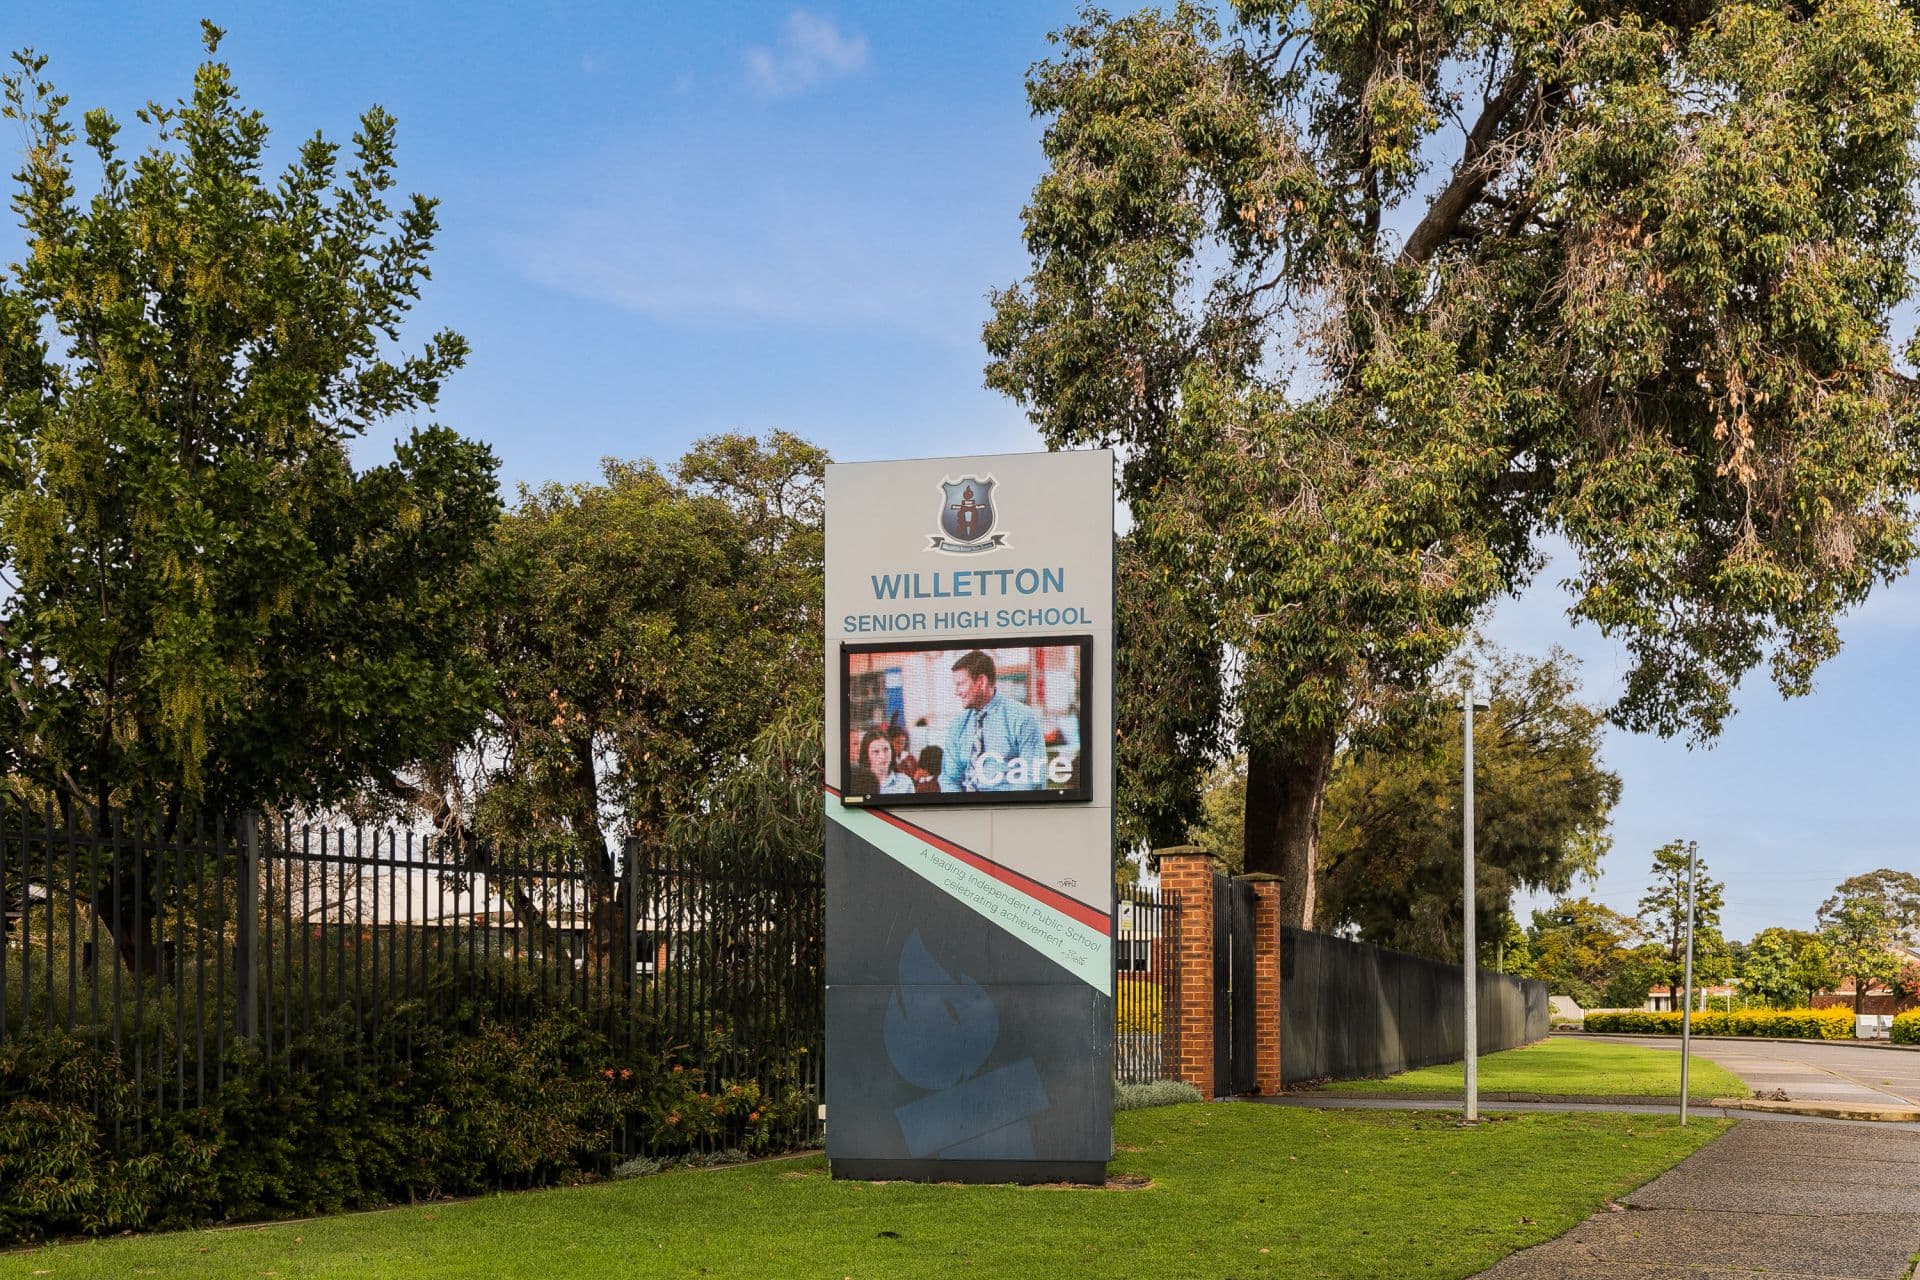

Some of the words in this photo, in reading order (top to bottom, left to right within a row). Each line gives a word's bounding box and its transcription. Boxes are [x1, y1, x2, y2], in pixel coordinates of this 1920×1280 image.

[871, 567, 1064, 600] WILLETTON
[844, 612, 926, 632] SENIOR
[934, 611, 988, 629] HIGH
[996, 607, 1092, 628] SCHOOL
[974, 753, 1073, 785] Care
[920, 848, 928, 859] A
[930, 853, 966, 880] leading
[968, 874, 1030, 914] Independent
[1032, 909, 1063, 932] Public
[1065, 926, 1101, 952] School
[943, 878, 999, 914] celebrating
[1000, 909, 1063, 948] achievement
